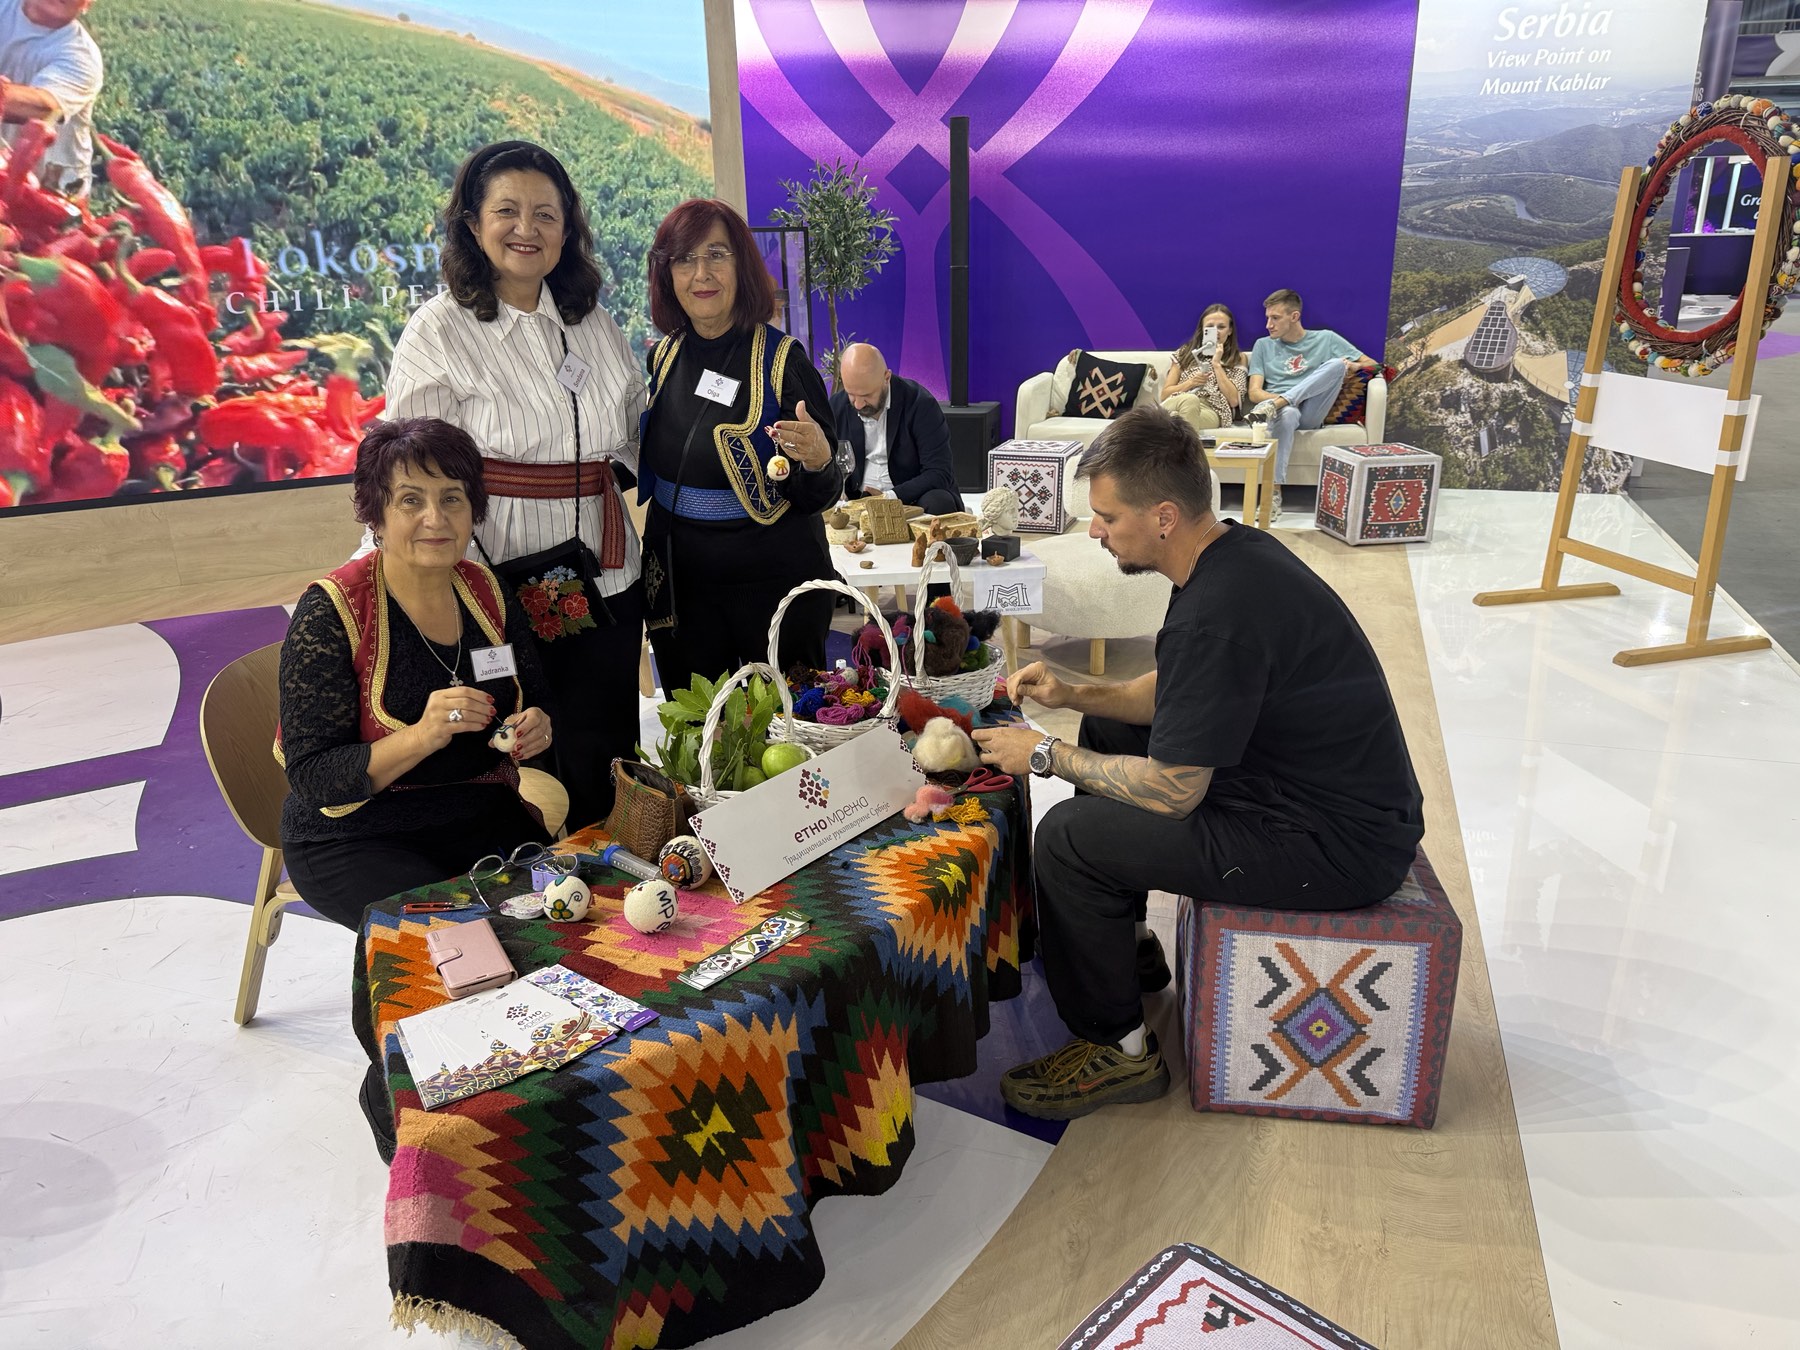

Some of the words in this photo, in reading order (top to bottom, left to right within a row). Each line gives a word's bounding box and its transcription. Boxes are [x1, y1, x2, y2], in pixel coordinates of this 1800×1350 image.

[1493, 2, 1613, 41] Serbia
[1487, 50, 1532, 68] View
[1534, 47, 1585, 66] Point
[1588, 49, 1612, 63] on
[1480, 76, 1543, 96] Mount
[1545, 72, 1612, 92] Kablar
[225, 285, 353, 315] CHILI
[707, 388, 720, 398] Olga
[480, 665, 509, 677] Jadranka
